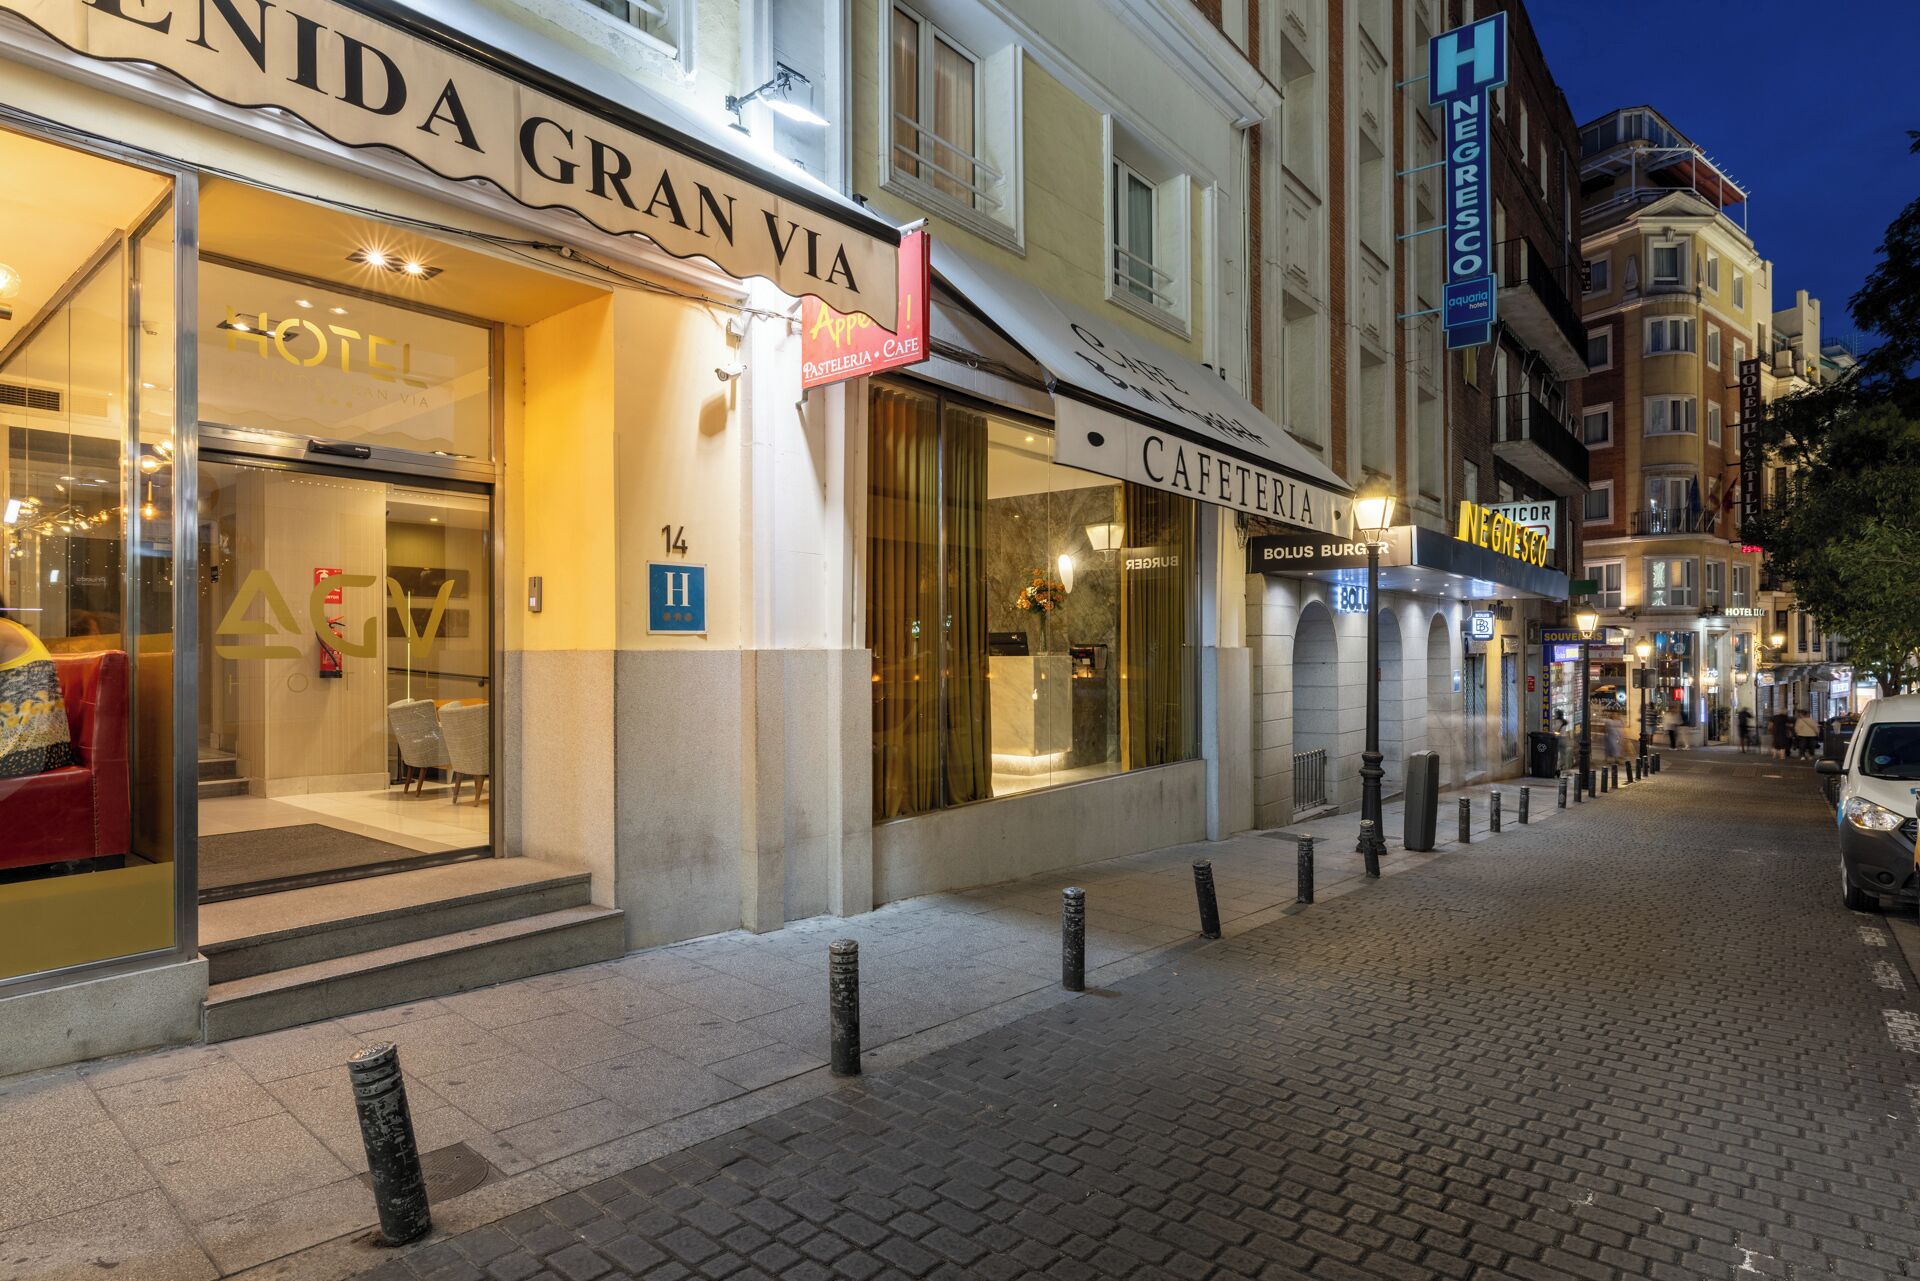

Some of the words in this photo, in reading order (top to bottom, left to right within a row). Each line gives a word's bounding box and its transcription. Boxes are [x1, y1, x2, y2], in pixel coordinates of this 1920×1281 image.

[1437, 20, 1495, 95] H
[519, 116, 738, 248] GRAN
[761, 209, 861, 294] VIA
[1452, 94, 1483, 276] NEGRESCO
[1449, 291, 1488, 307] aquaria
[1469, 301, 1488, 309] hotels
[226, 305, 429, 389] HOTEL
[1743, 363, 1757, 419] HOTEL
[1142, 435, 1315, 525] CAFETERIA
[661, 524, 689, 556] 14
[1263, 546, 1314, 560] BOLUS
[1320, 541, 1390, 558] BURGR
[1458, 500, 1548, 568] NEGRESCO
[215, 569, 456, 659] AGV
[664, 571, 692, 608] H
[1725, 607, 1752, 617] HOTEL
[1543, 632, 1603, 642] SOUVENRS
